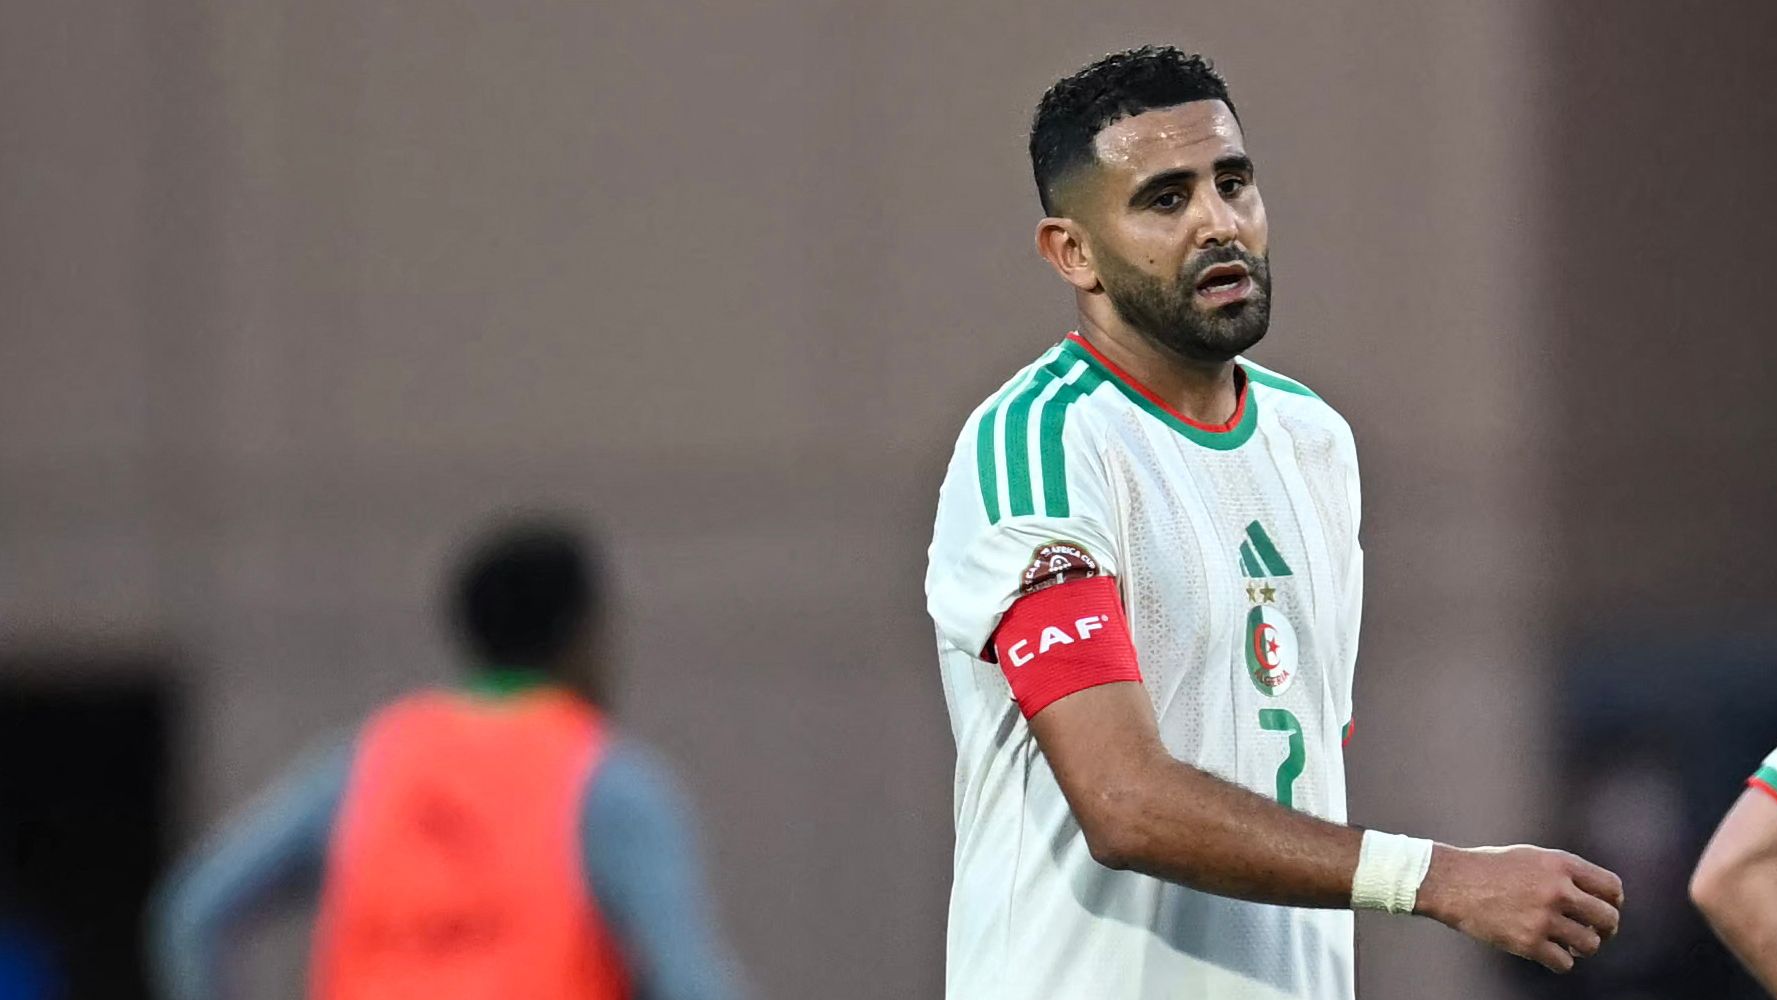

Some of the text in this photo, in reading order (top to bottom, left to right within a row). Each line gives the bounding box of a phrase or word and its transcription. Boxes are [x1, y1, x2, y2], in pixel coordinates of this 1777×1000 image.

[1007, 615, 1103, 667] CAF
[1254, 669, 1290, 687] ALGERIA
[1258, 708, 1306, 809] 7
